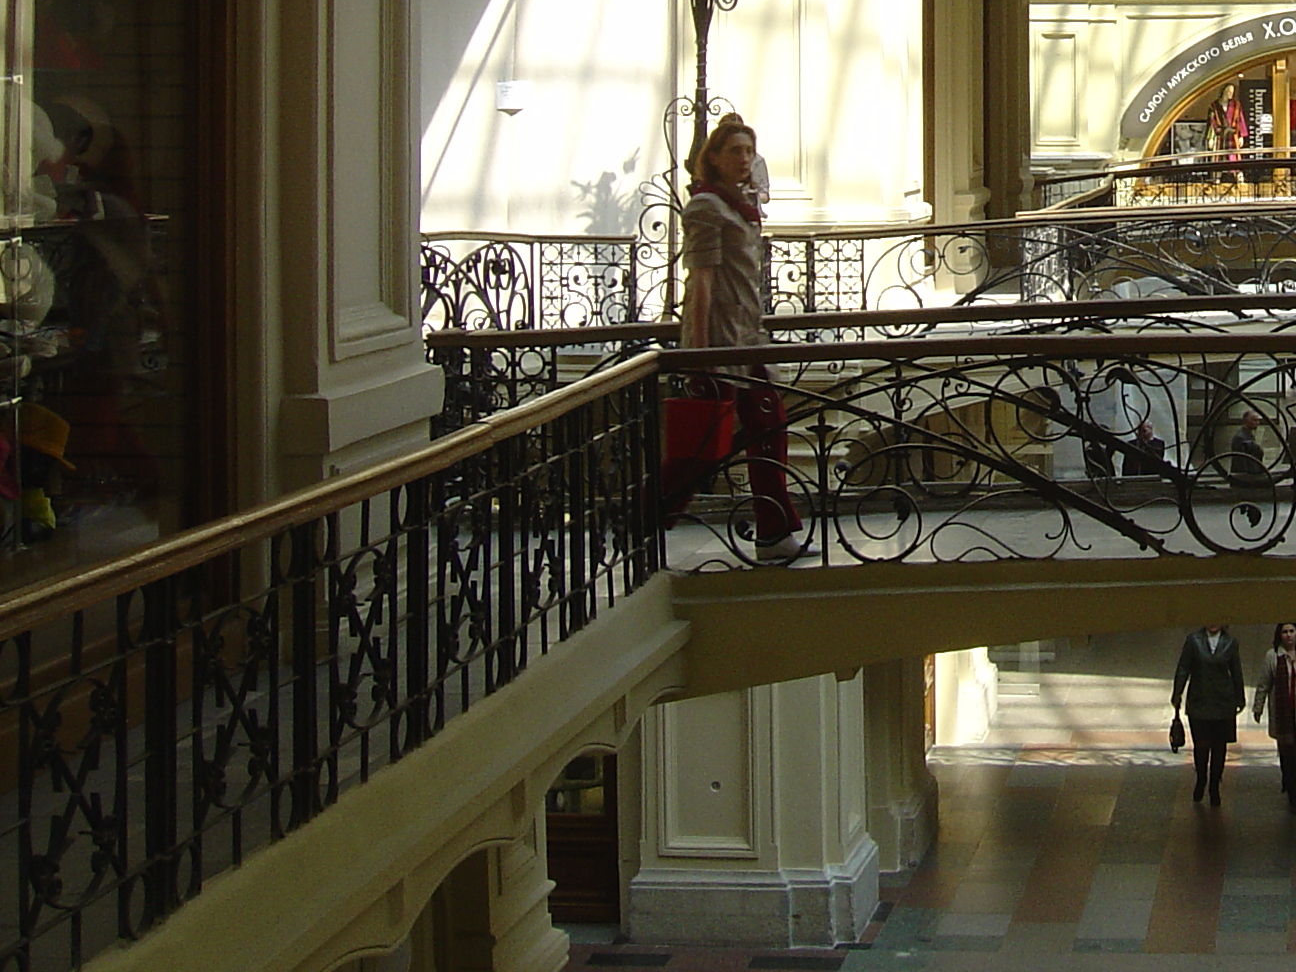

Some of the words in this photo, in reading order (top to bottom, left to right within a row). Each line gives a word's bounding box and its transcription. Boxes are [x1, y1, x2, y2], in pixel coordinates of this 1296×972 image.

[1139, 87, 1168, 123] САЛОН
[1167, 47, 1220, 90] МУЖСКОГО
[1222, 31, 1254, 52] БЕЛЬЯ
